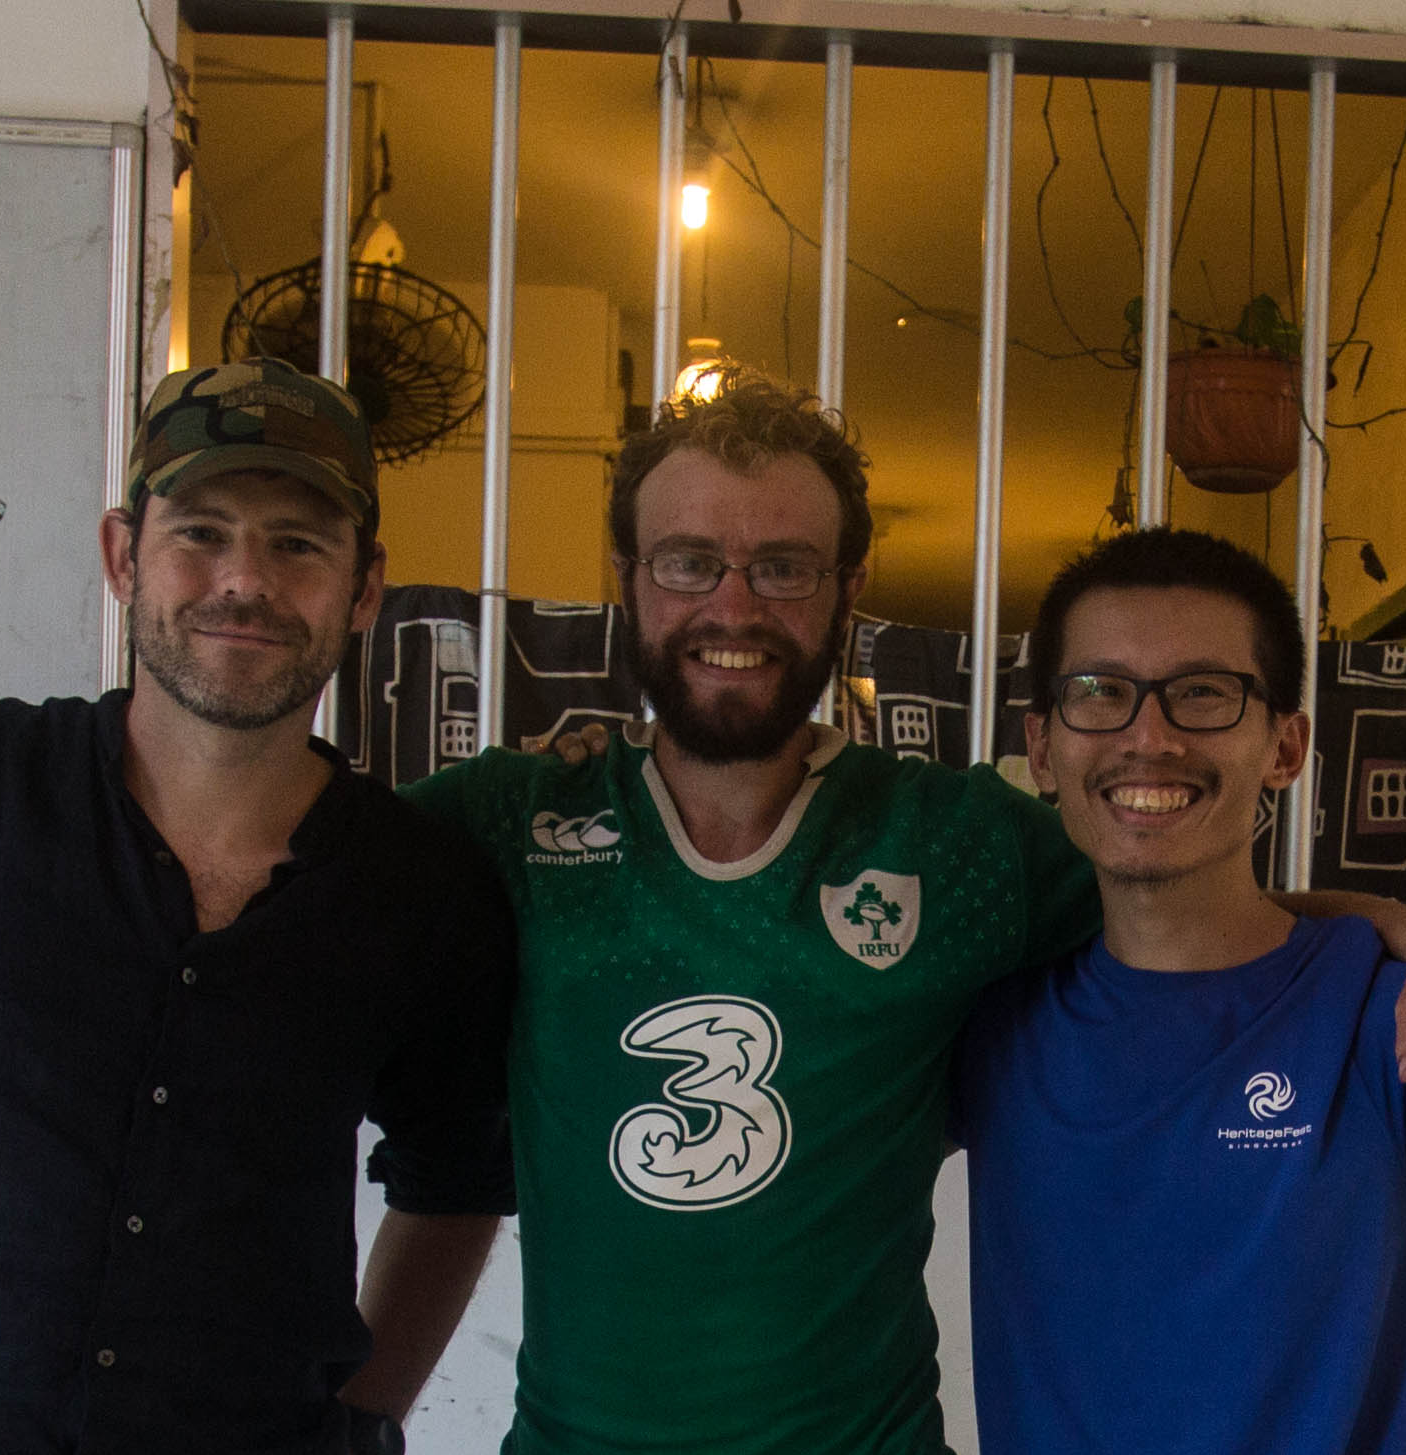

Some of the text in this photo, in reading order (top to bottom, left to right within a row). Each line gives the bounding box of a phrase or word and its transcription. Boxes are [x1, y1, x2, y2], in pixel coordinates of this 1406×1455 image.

[525, 847, 624, 866] canterbury
[857, 942, 901, 958] IRFU
[1217, 1124, 1313, 1140] HeritageFest
